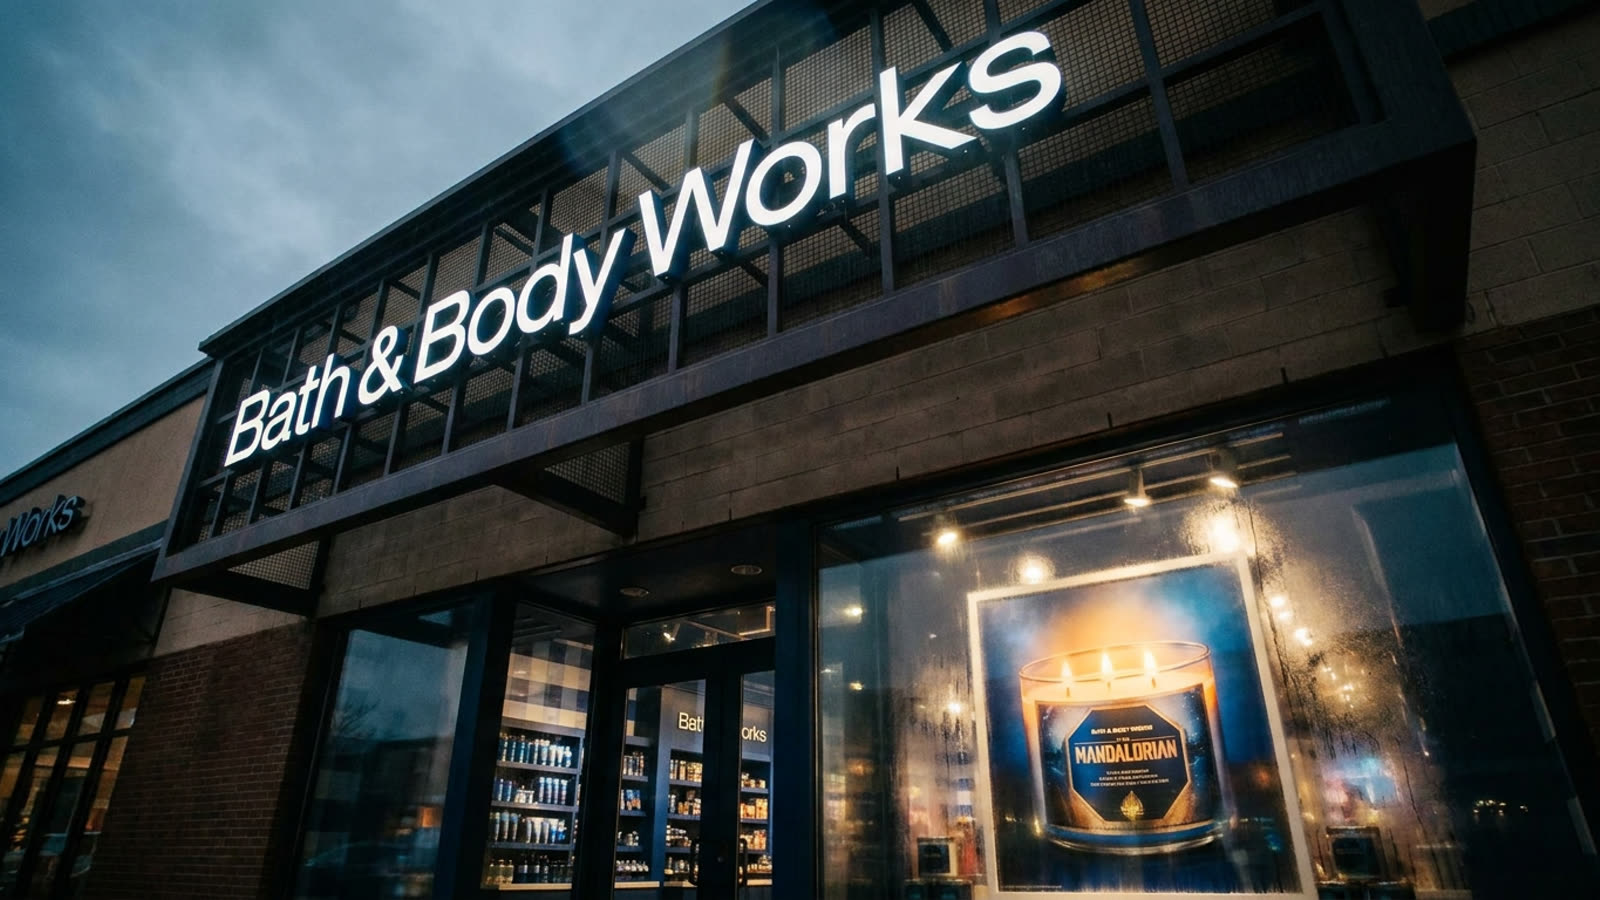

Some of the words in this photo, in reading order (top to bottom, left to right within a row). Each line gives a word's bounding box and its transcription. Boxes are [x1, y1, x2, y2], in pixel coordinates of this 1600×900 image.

[223, 353, 352, 467] Bath
[358, 325, 404, 405] &
[413, 227, 627, 384] Body
[638, 31, 1063, 277] Works
[0, 494, 78, 557] Works
[678, 712, 704, 732] Bat
[741, 725, 767, 743] orks
[1074, 740, 1178, 764] MANDALORIAN
